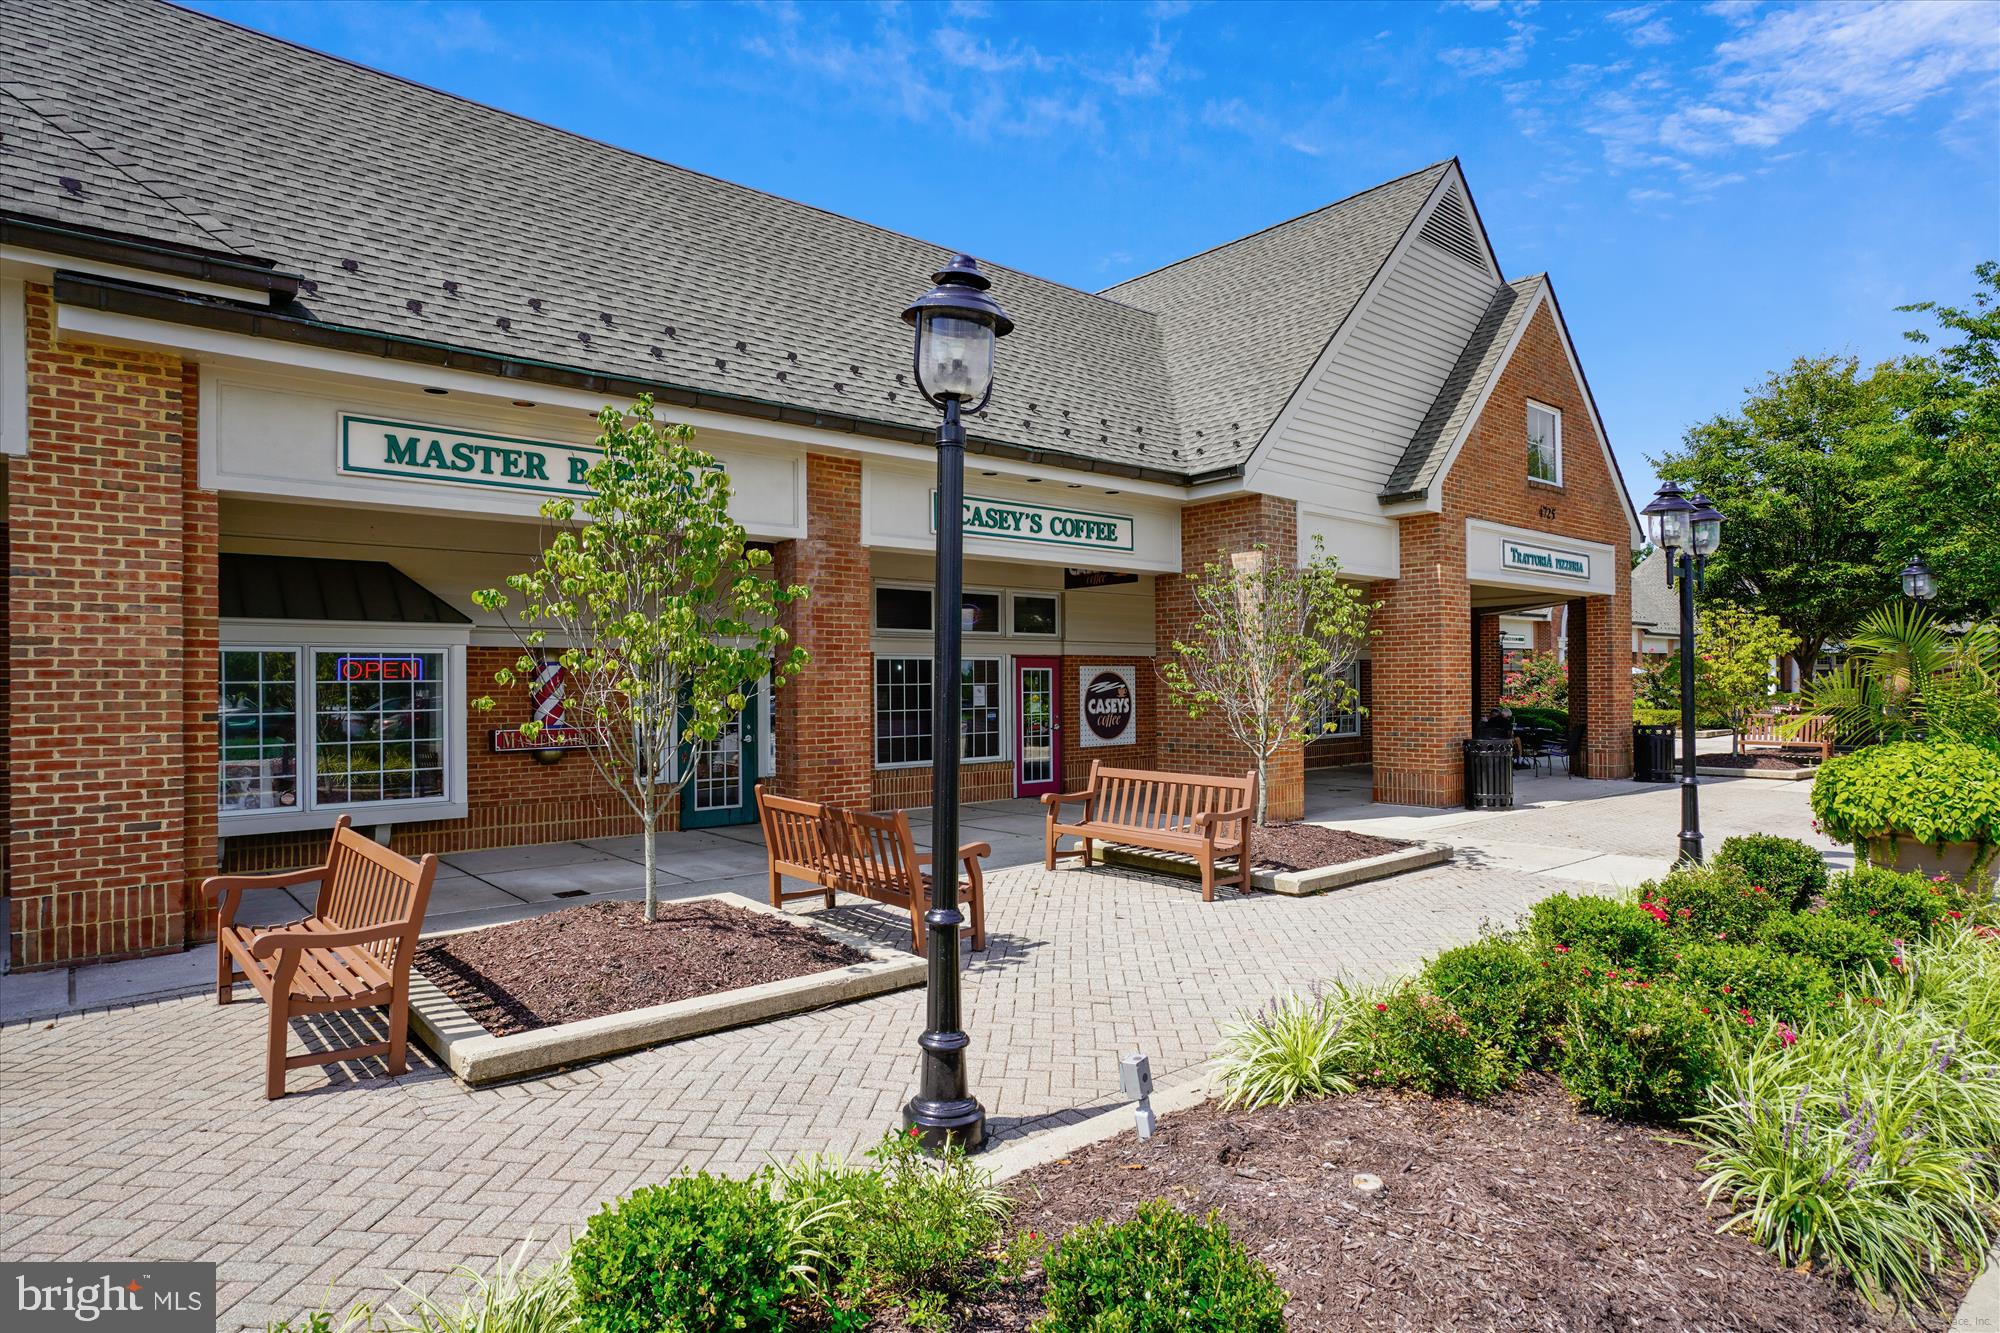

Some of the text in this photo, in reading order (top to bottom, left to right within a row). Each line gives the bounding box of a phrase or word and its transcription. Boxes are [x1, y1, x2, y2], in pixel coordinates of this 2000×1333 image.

[384, 433, 550, 481] MASTER
[1538, 504, 1556, 520] 4725
[961, 504, 1118, 542] CASEY'S COFFEE
[342, 661, 417, 680] OPEN
[1087, 698, 1130, 714] CASEYS
[1097, 713, 1122, 728] coffee
